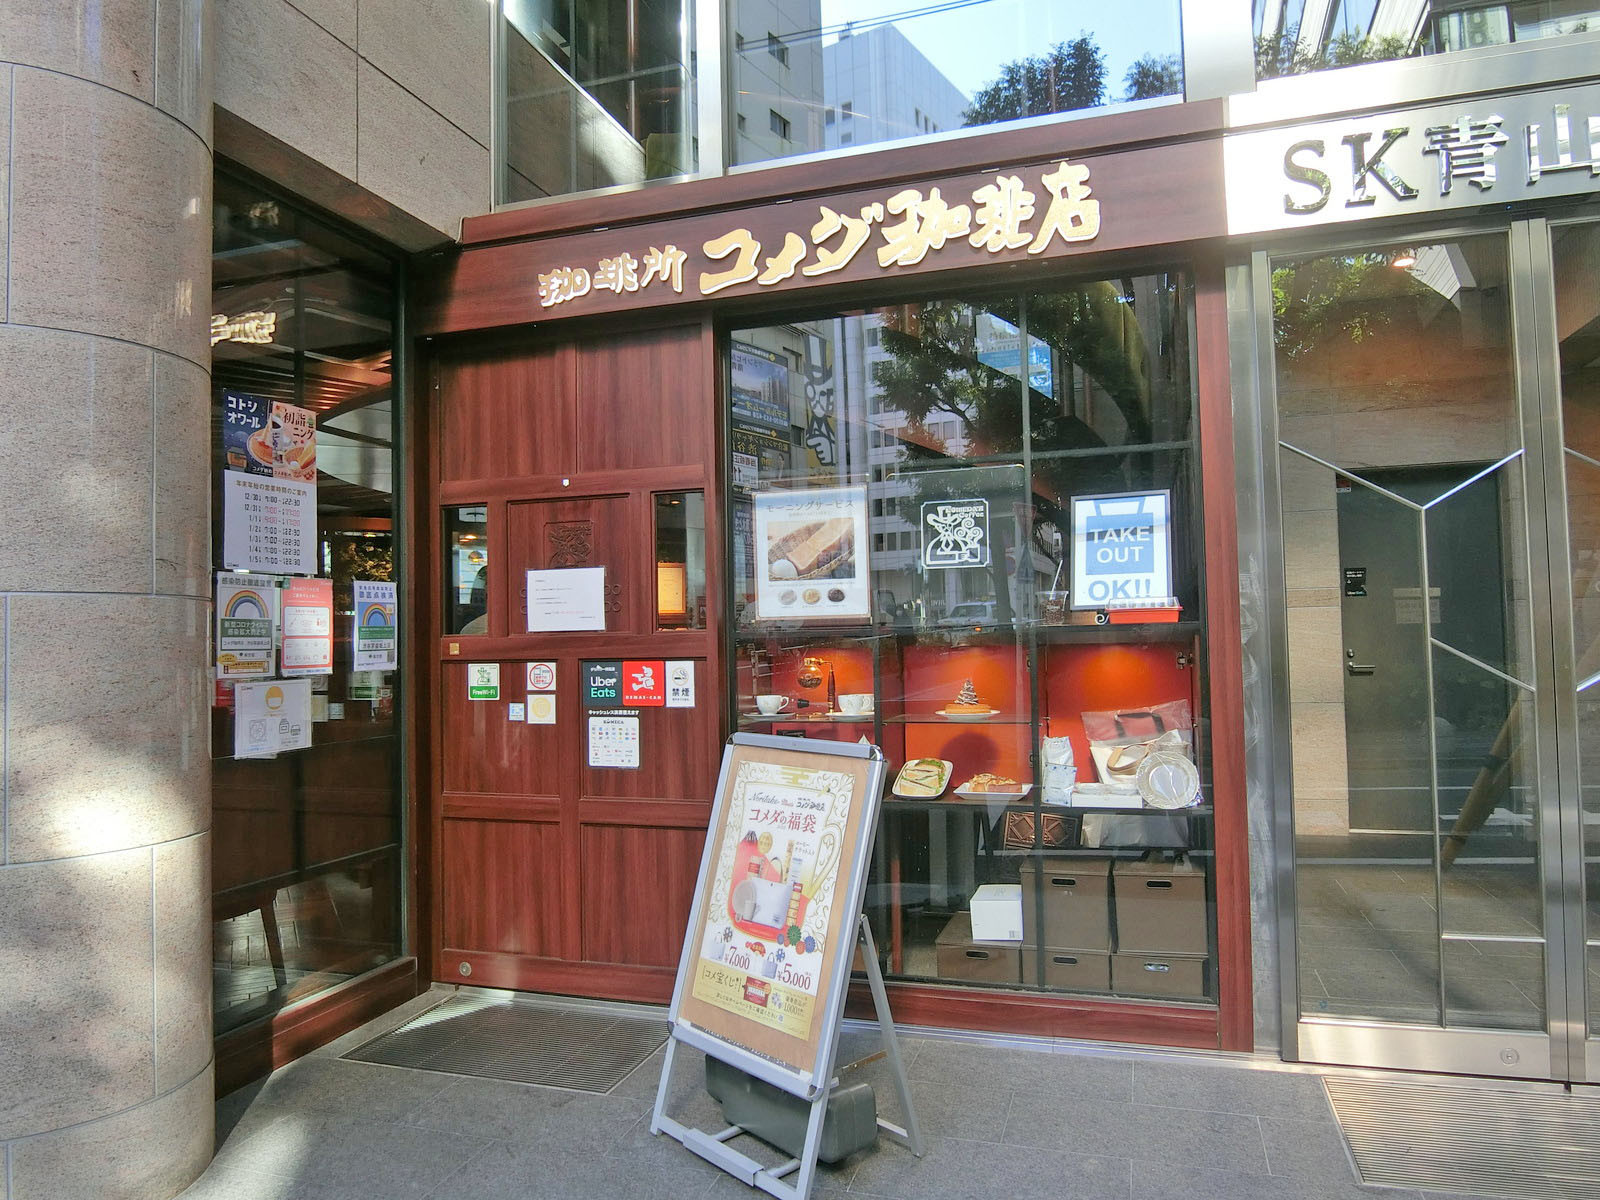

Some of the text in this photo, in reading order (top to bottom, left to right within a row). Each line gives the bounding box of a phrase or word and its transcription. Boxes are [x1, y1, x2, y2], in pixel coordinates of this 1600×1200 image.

[538, 162, 1101, 308] 珈琲所 コメダ珈琲店
[227, 395, 258, 413] コトシ
[227, 412, 261, 428] オワール
[768, 500, 855, 512] モーニングサービス
[1090, 526, 1150, 544] TAKE
[1096, 545, 1144, 564] OUT
[1088, 579, 1151, 601] OK!!
[590, 676, 615, 687] Uber
[591, 687, 616, 698] Eats
[672, 687, 690, 696] 禁煙
[749, 809, 816, 834] コメダの福袋
[725, 946, 750, 970] ¥7,000
[777, 963, 811, 990] ¥5,000
